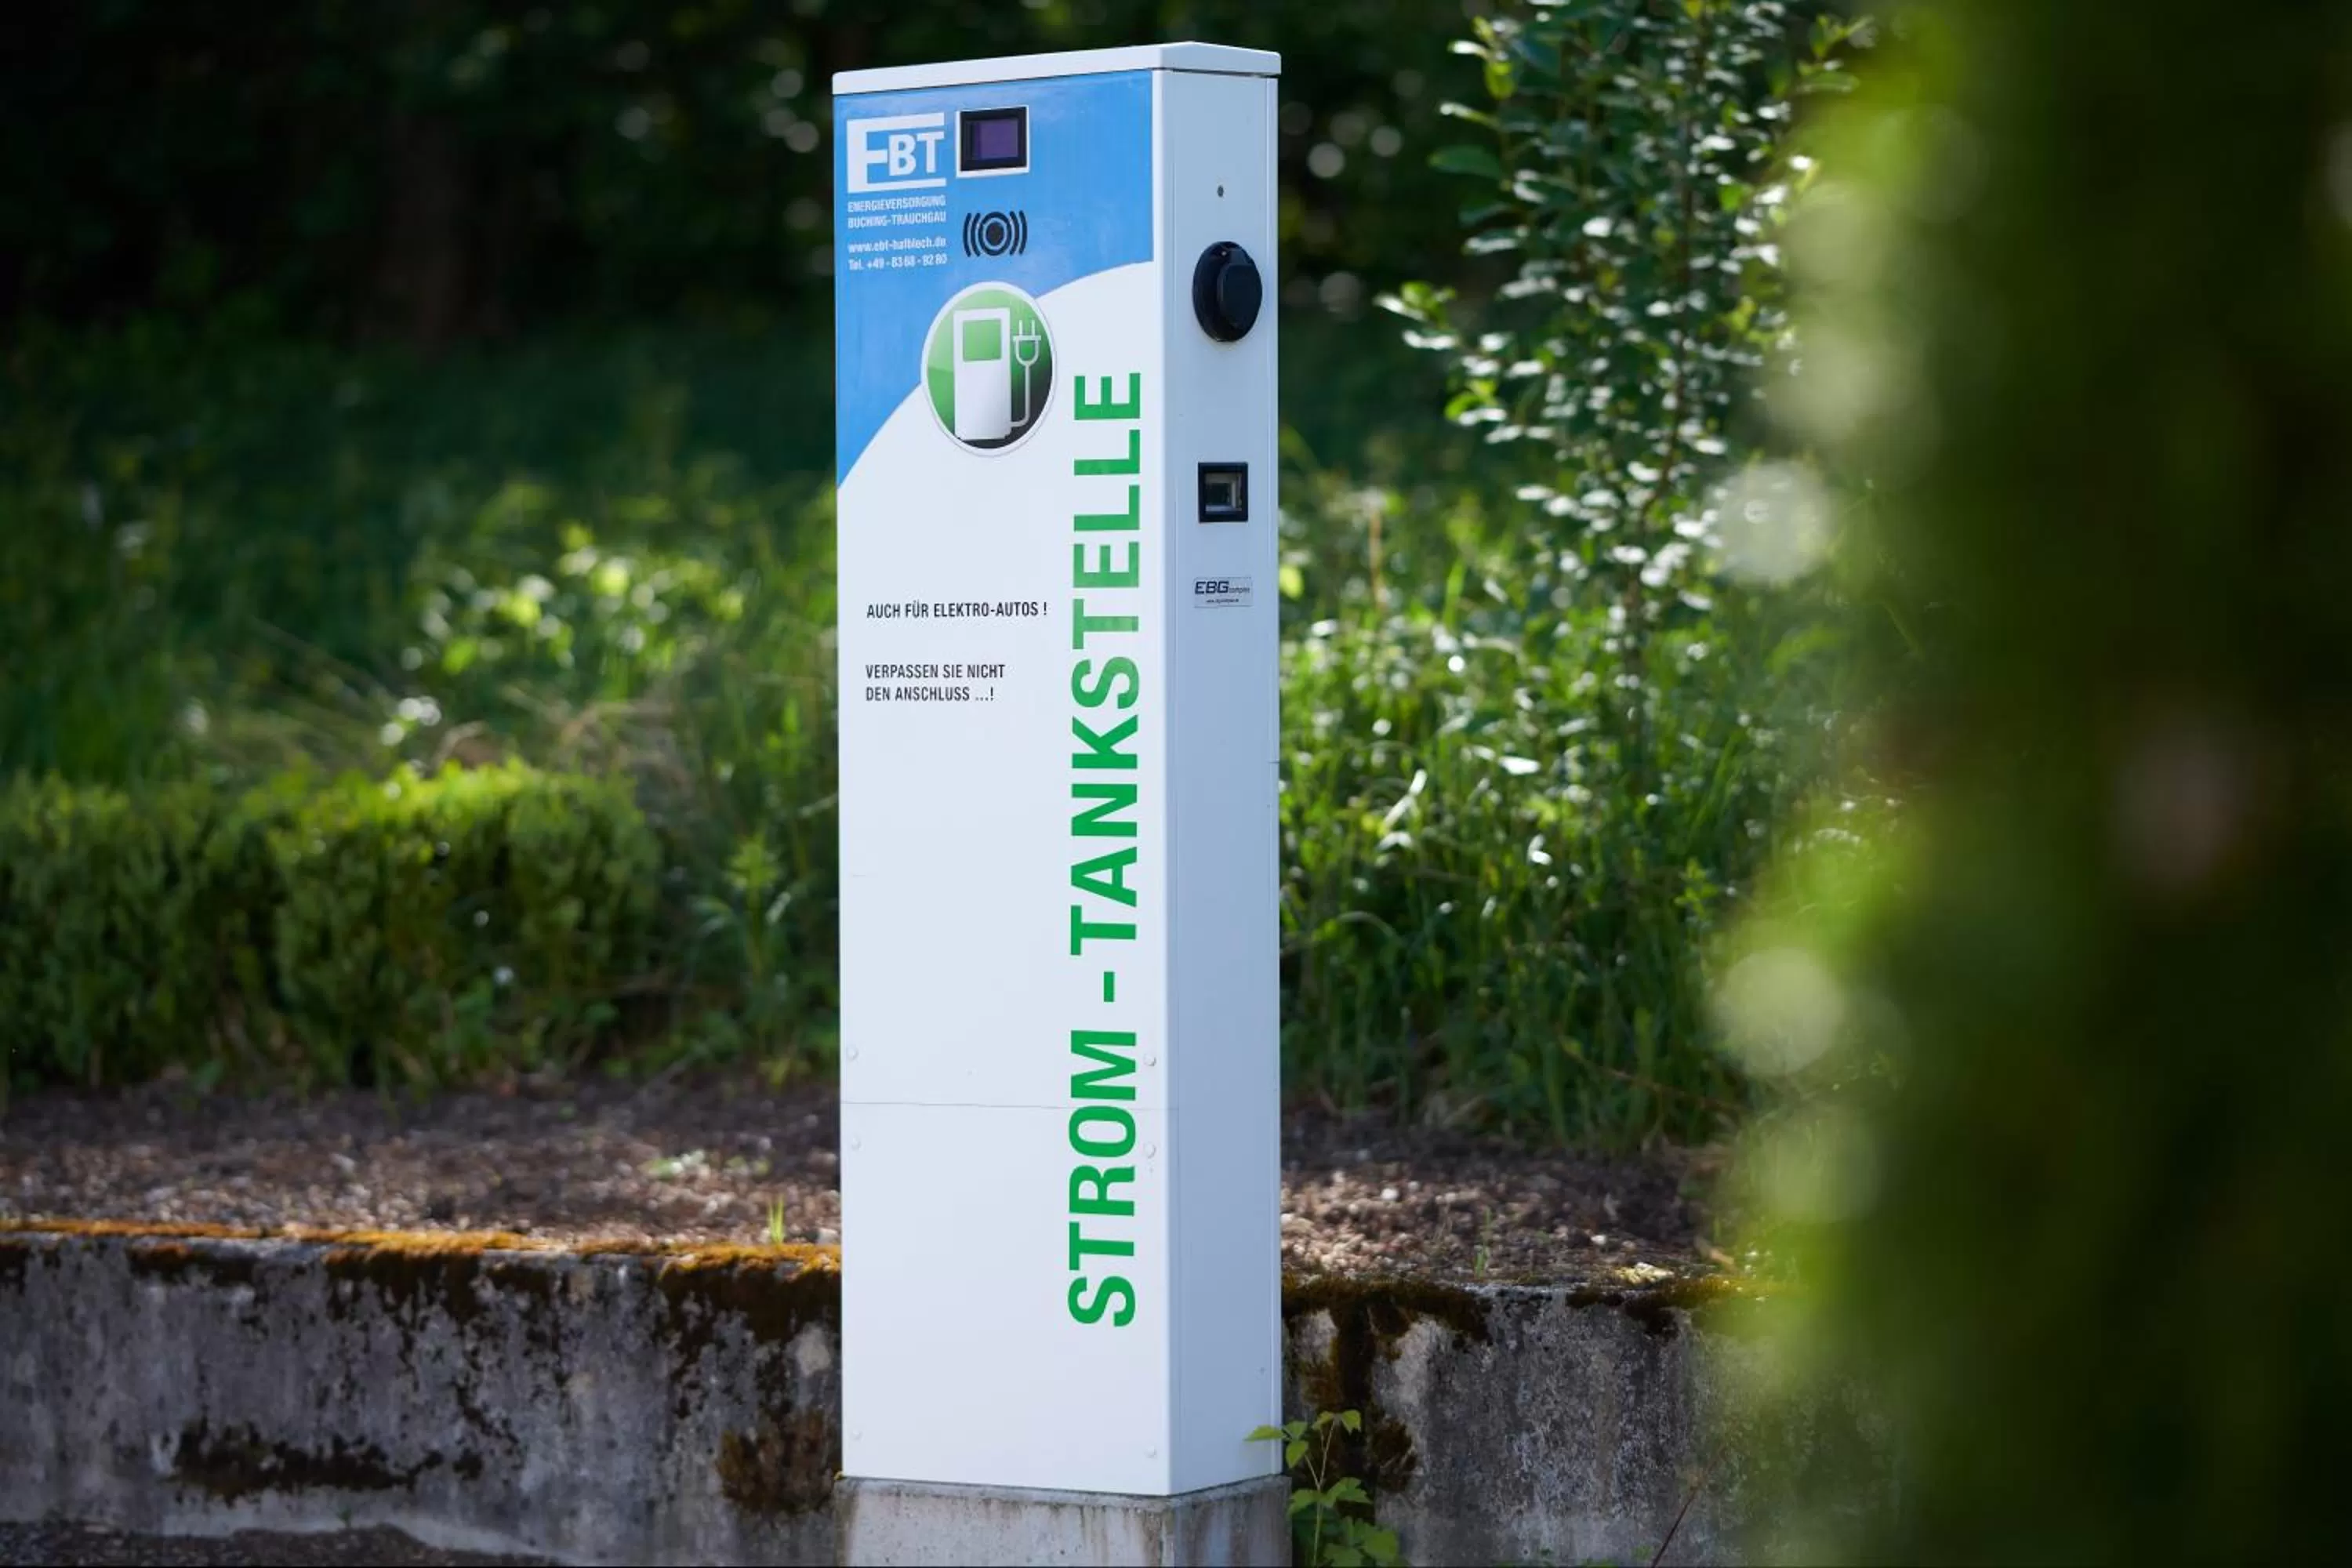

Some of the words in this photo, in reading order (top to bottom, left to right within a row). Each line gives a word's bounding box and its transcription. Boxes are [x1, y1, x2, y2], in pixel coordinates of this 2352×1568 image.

[847, 112, 946, 194] EBT
[848, 194, 946, 212] ENERGIEVERSORGUNG
[848, 211, 946, 229] BUCHING-TRAUCHGAU
[848, 259, 863, 270] Tel.
[866, 603, 900, 619] AUCH
[905, 600, 929, 618] FÜR
[934, 601, 1038, 618] ELEKTRO-AUTOS
[866, 664, 938, 679] VERPASSEN
[942, 664, 963, 678] SIE
[967, 664, 1005, 678] NICHT
[1069, 372, 1142, 956] TANKSTELLE
[866, 687, 890, 701] DEN
[895, 687, 970, 701] ANSCHLUSS
[1067, 1029, 1138, 1328] STROM
